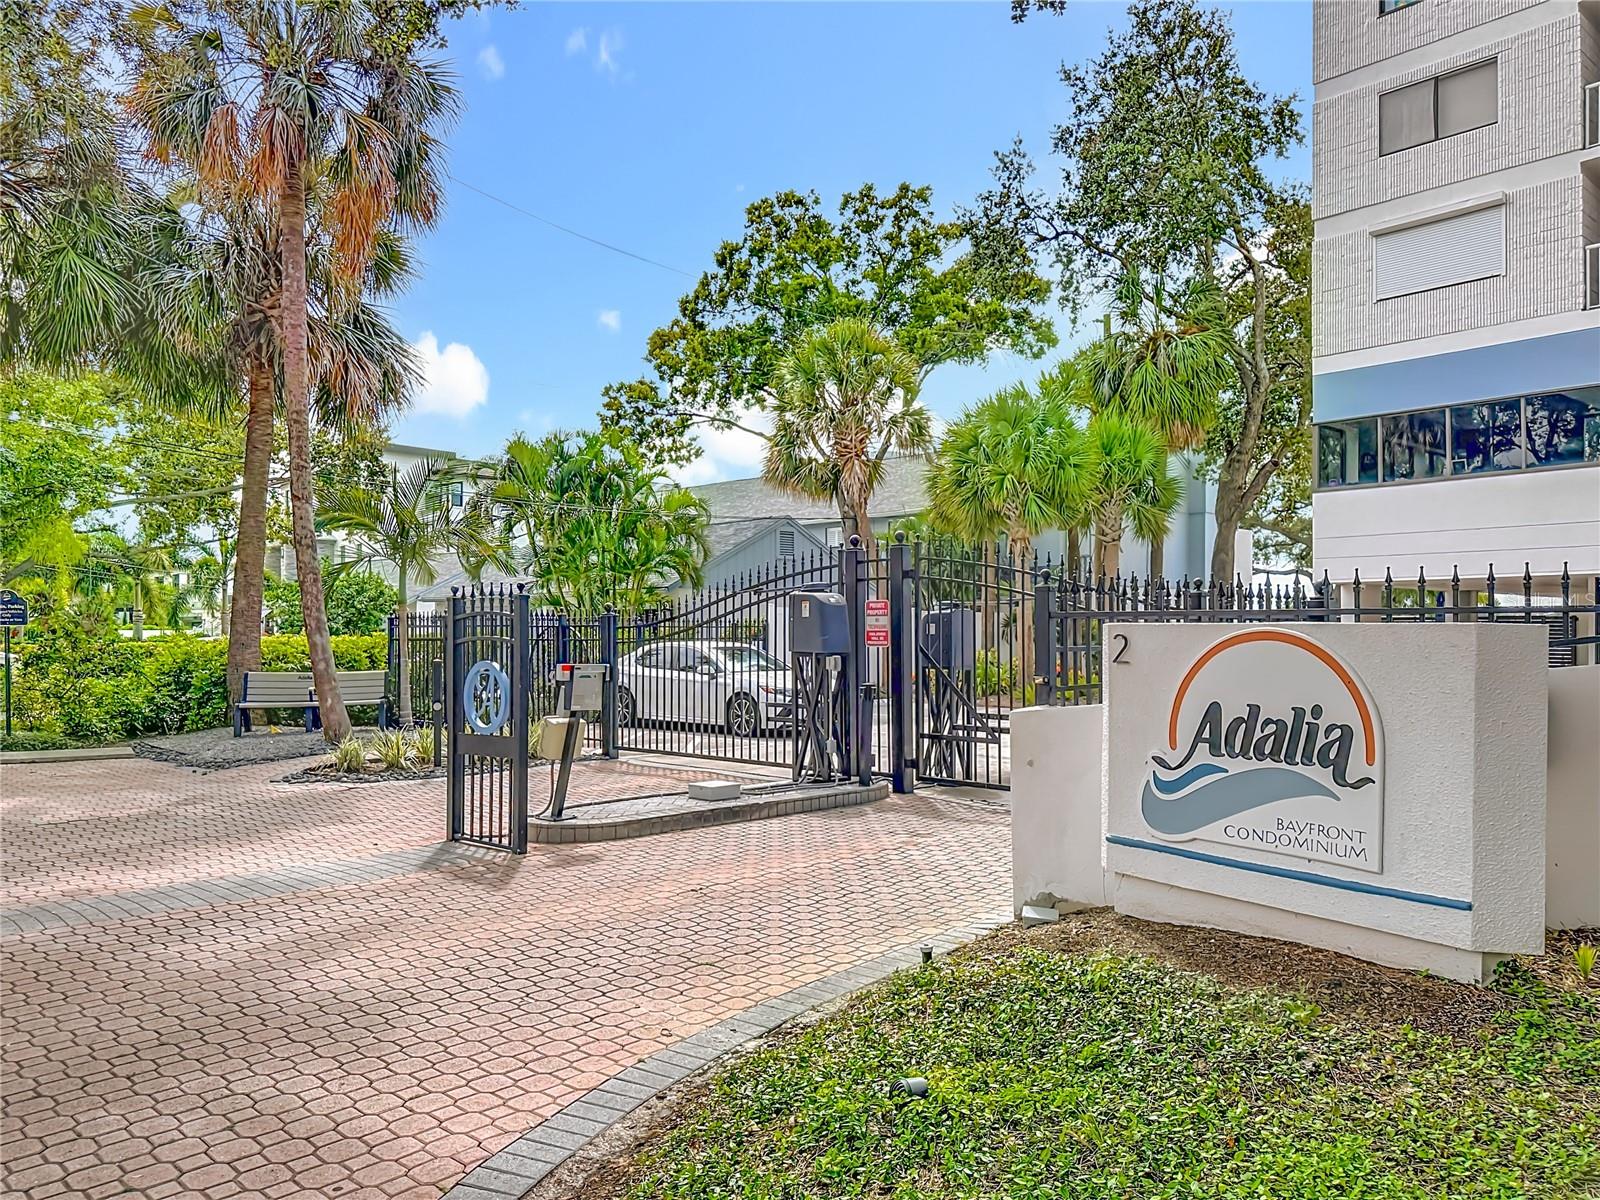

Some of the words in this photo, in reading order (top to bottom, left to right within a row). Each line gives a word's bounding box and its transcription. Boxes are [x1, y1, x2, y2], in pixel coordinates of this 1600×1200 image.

[1112, 633, 1130, 664] 2
[1152, 701, 1375, 789] Adalia
[1224, 825, 1368, 861] CONDOMINIUM
[1276, 817, 1367, 841] BAYFRONT
